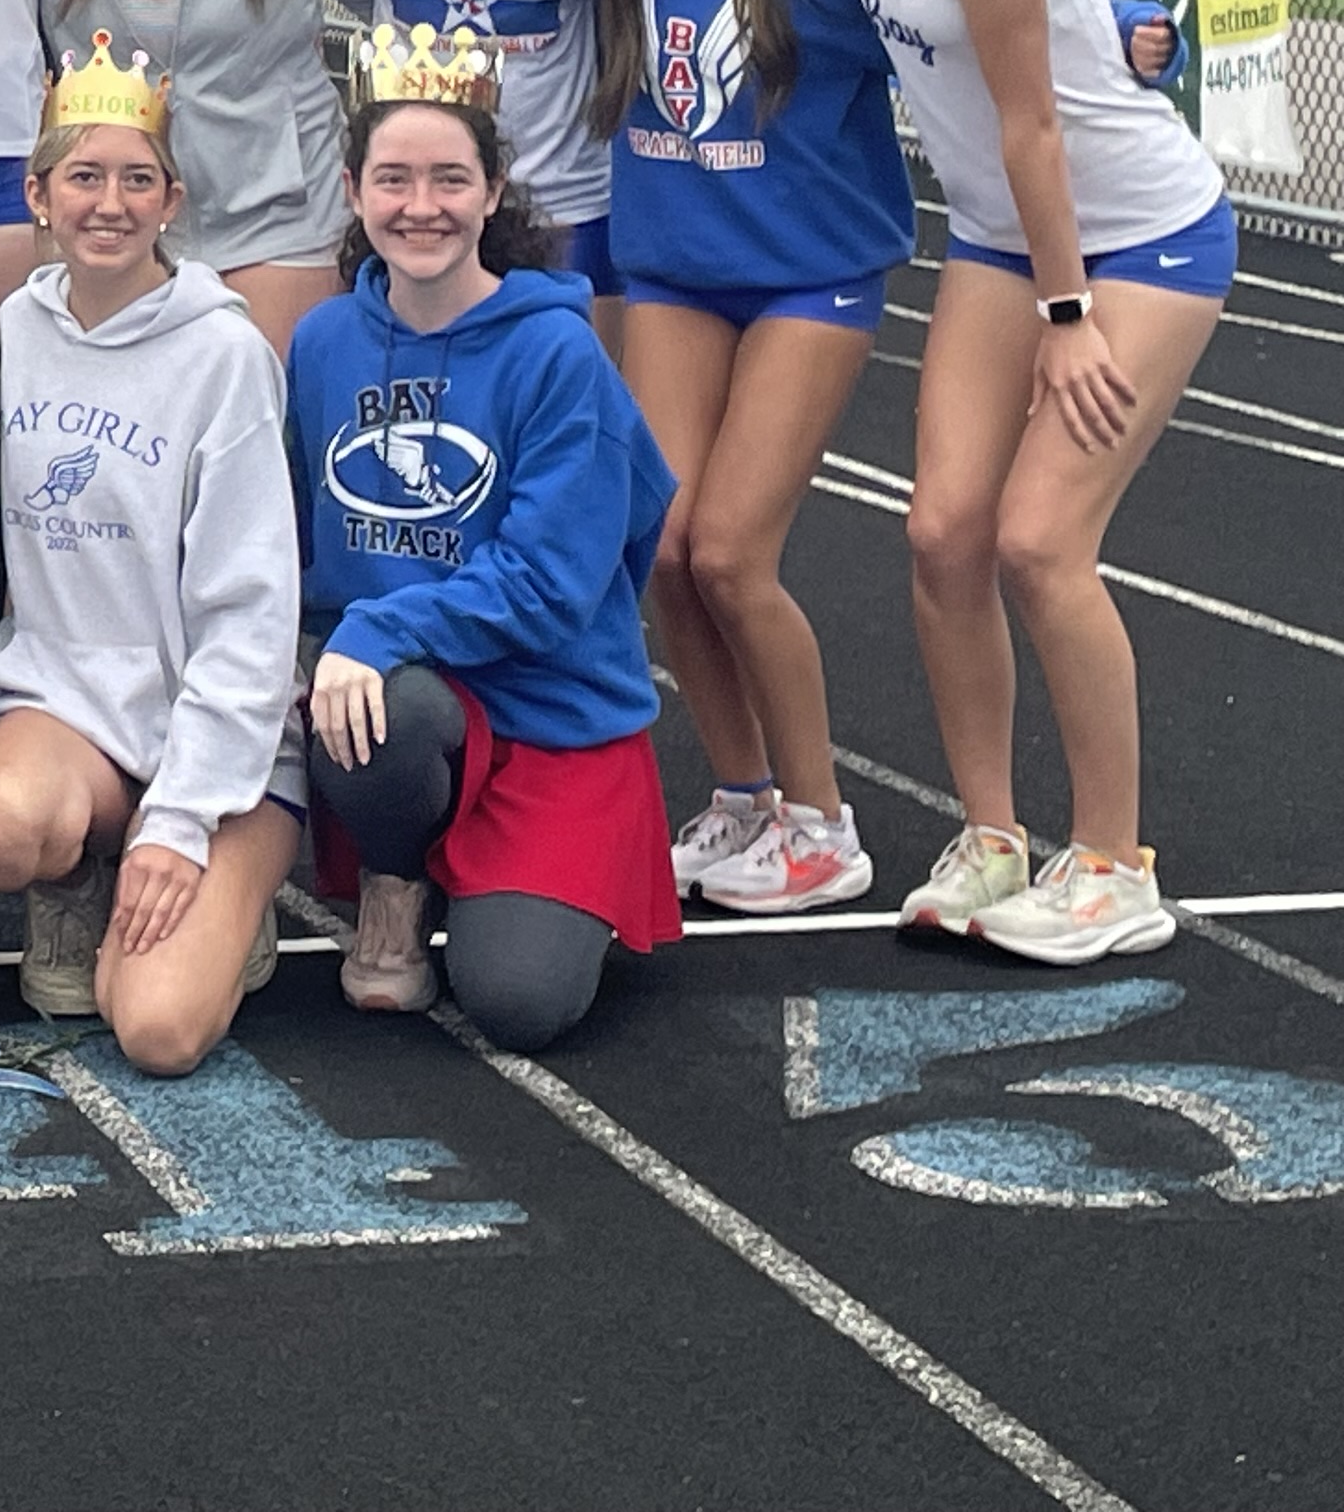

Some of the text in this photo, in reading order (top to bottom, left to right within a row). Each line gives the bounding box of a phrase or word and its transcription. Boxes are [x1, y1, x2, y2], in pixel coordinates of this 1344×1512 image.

[663, 16, 698, 132] BAY
[698, 140, 766, 172] FIELD
[355, 377, 451, 430] BAY
[0, 400, 169, 468] AY GIRLS
[343, 513, 464, 565] TRACK
[782, 978, 1344, 1208] 5
